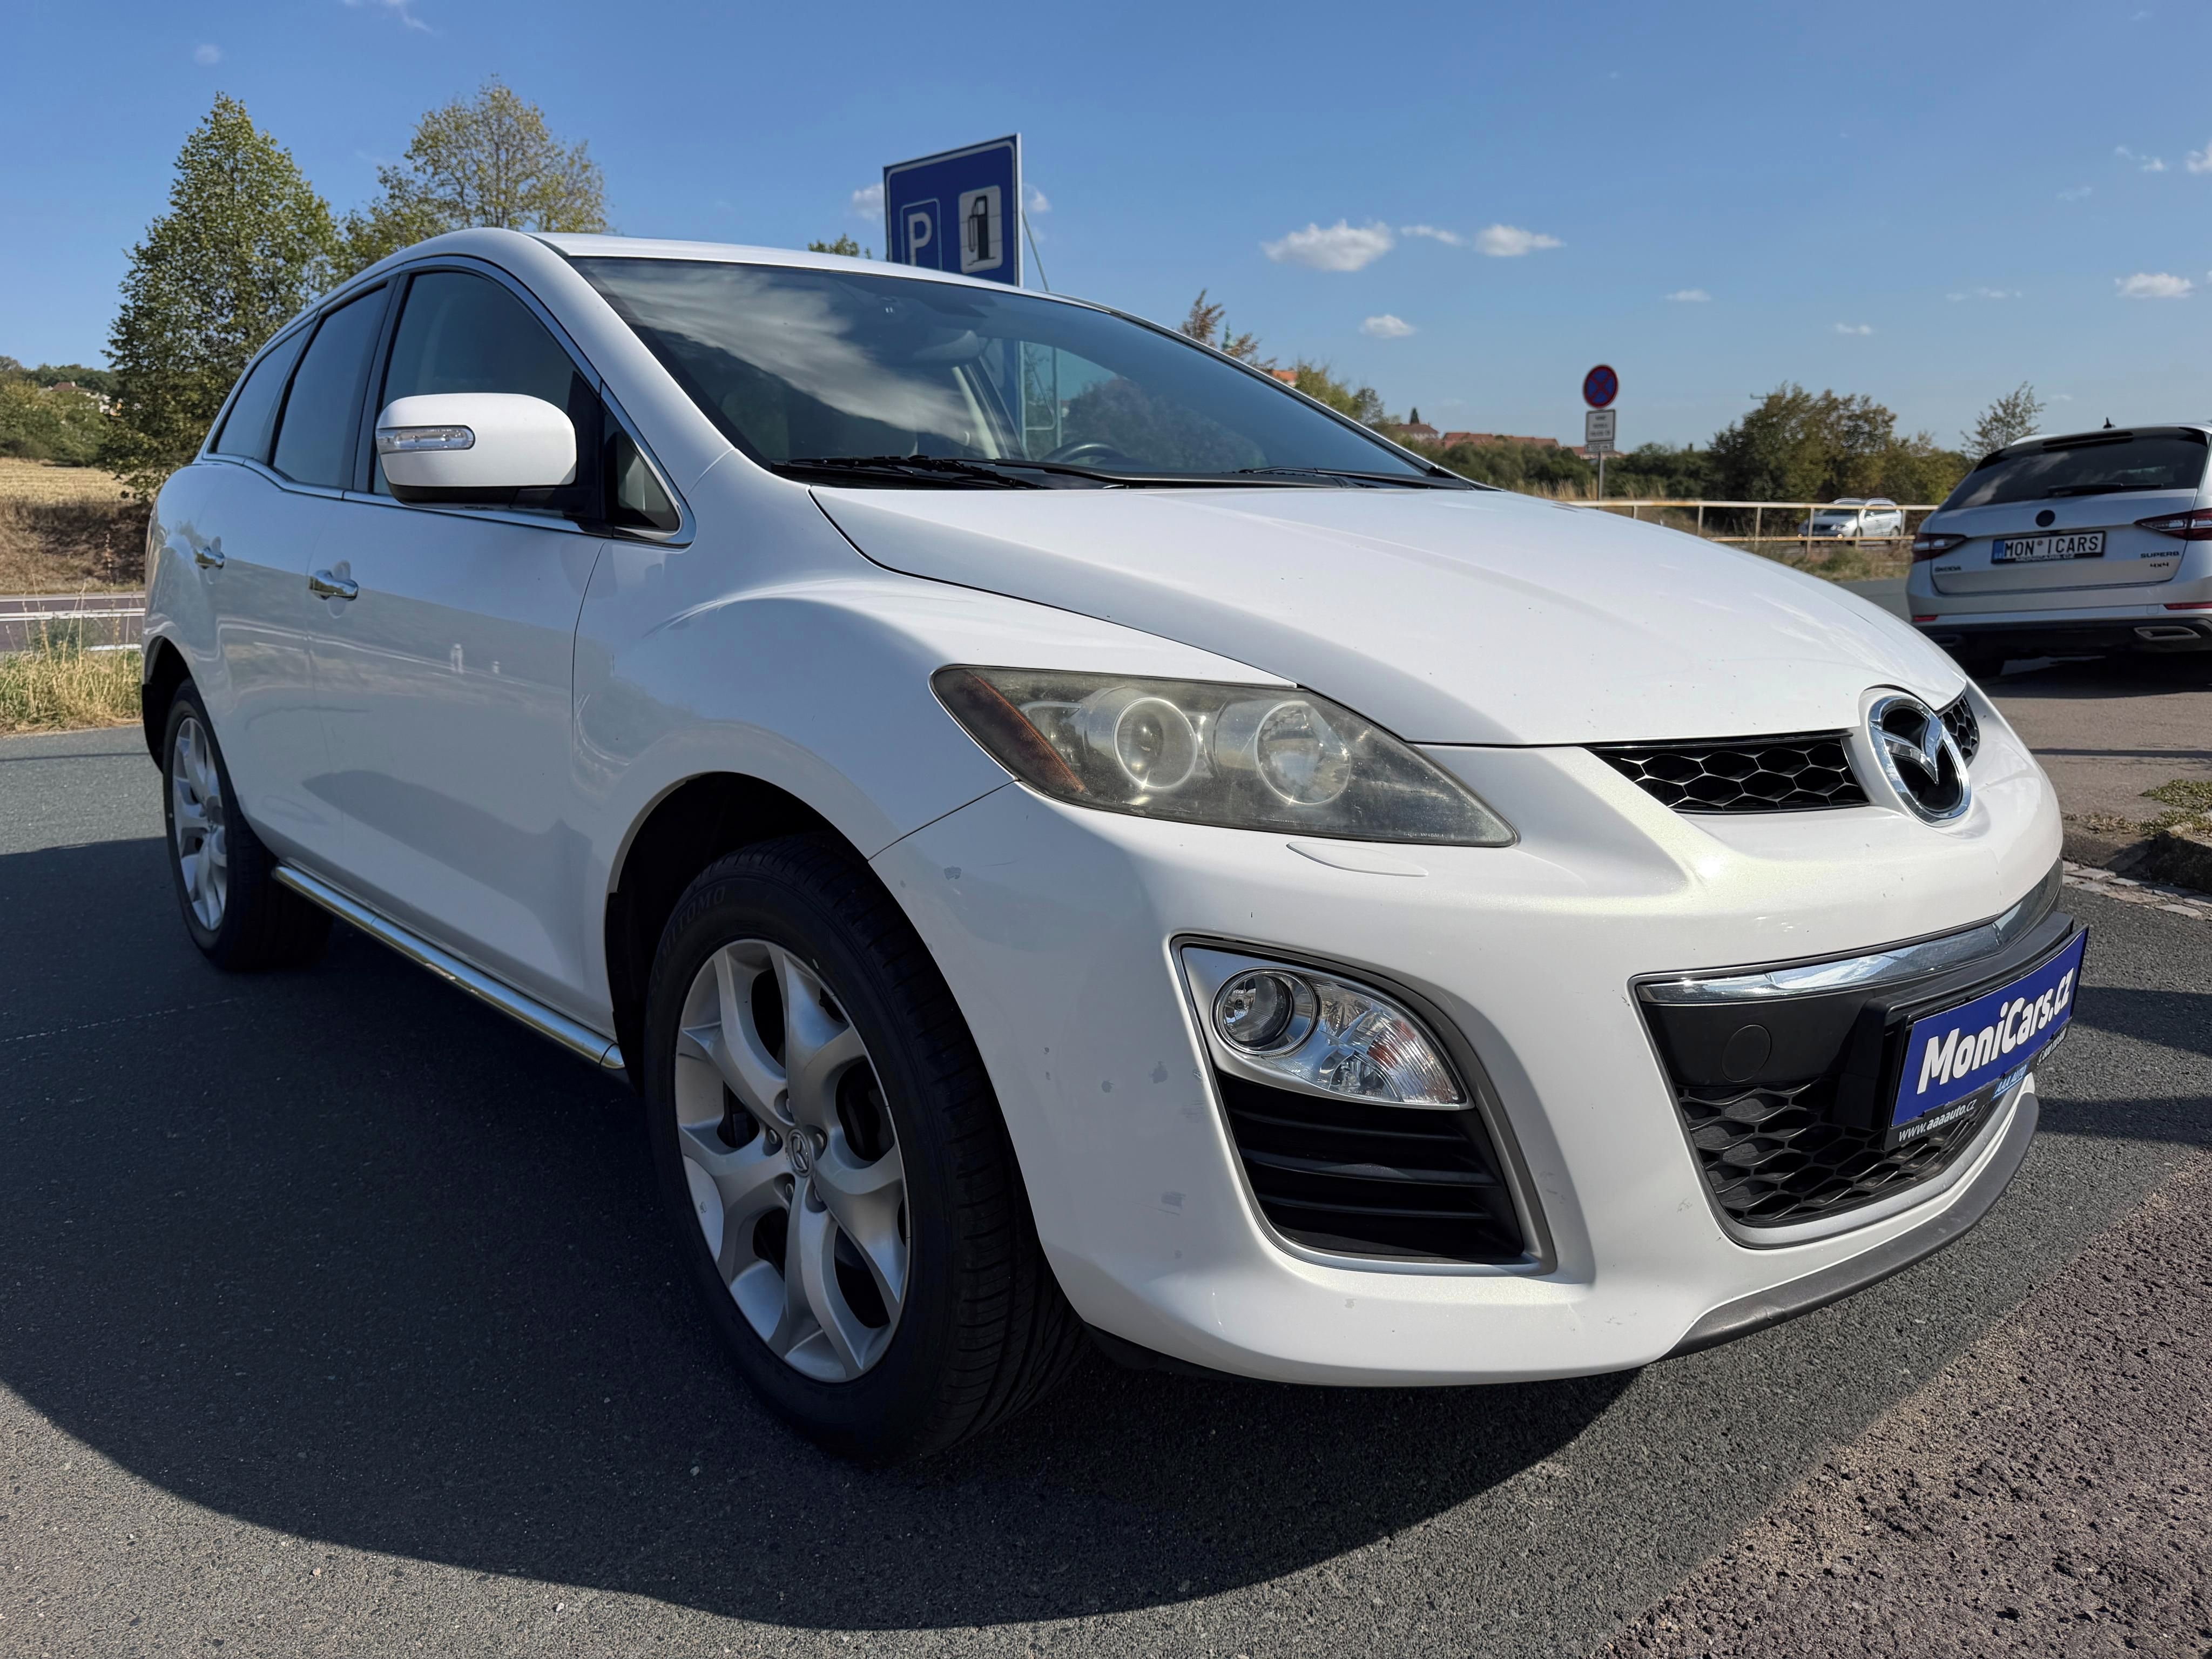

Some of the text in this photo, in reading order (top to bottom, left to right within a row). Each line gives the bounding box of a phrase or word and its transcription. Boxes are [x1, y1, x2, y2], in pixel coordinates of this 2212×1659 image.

[908, 212, 933, 266] P
[2004, 540, 2034, 557] MON
[1917, 967, 2074, 1095] MoniCars.cz
[1995, 1064, 2027, 1094] AAA AUTO
[1899, 1098, 1977, 1142] www.aaaauto.cz
